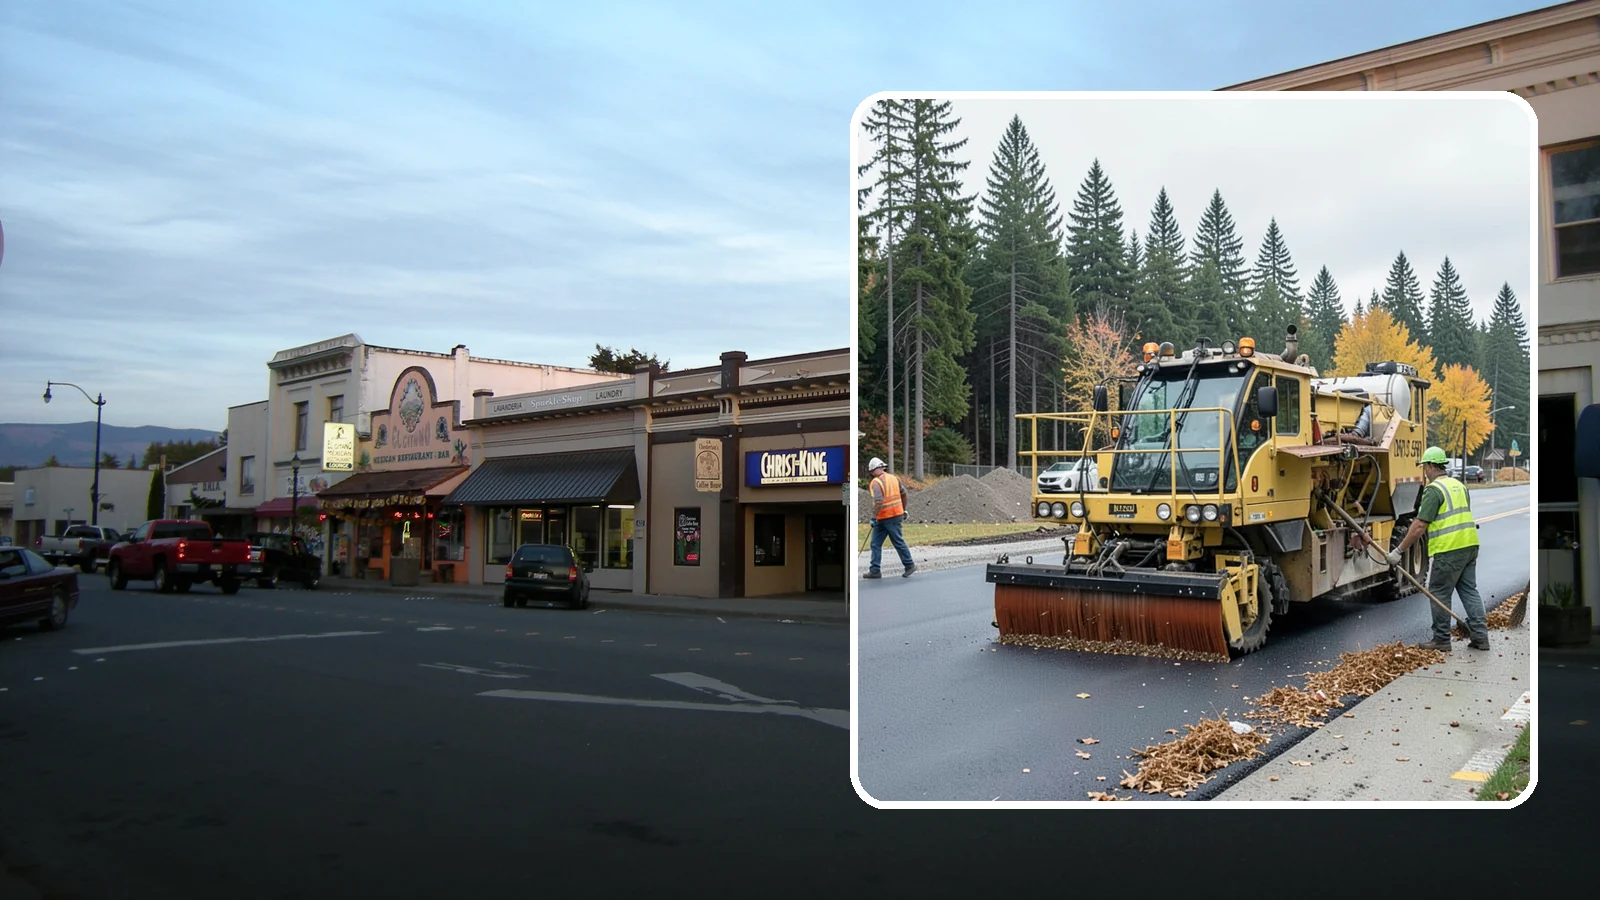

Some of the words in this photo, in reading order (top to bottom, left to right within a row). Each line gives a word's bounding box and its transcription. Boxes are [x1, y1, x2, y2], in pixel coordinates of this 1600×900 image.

[595, 389, 624, 400] LAUNDRY
[494, 402, 523, 412] LAVANDERIA
[531, 396, 562, 409] Sparkle
[562, 395, 582, 405] Shop
[373, 454, 397, 464] MEXICAN
[397, 451, 433, 462] RESTAURANT
[438, 450, 450, 459] BAR
[760, 451, 797, 478] CHRIST
[798, 449, 827, 476] KING
[696, 480, 709, 489] Coffee
[710, 480, 722, 489] House
